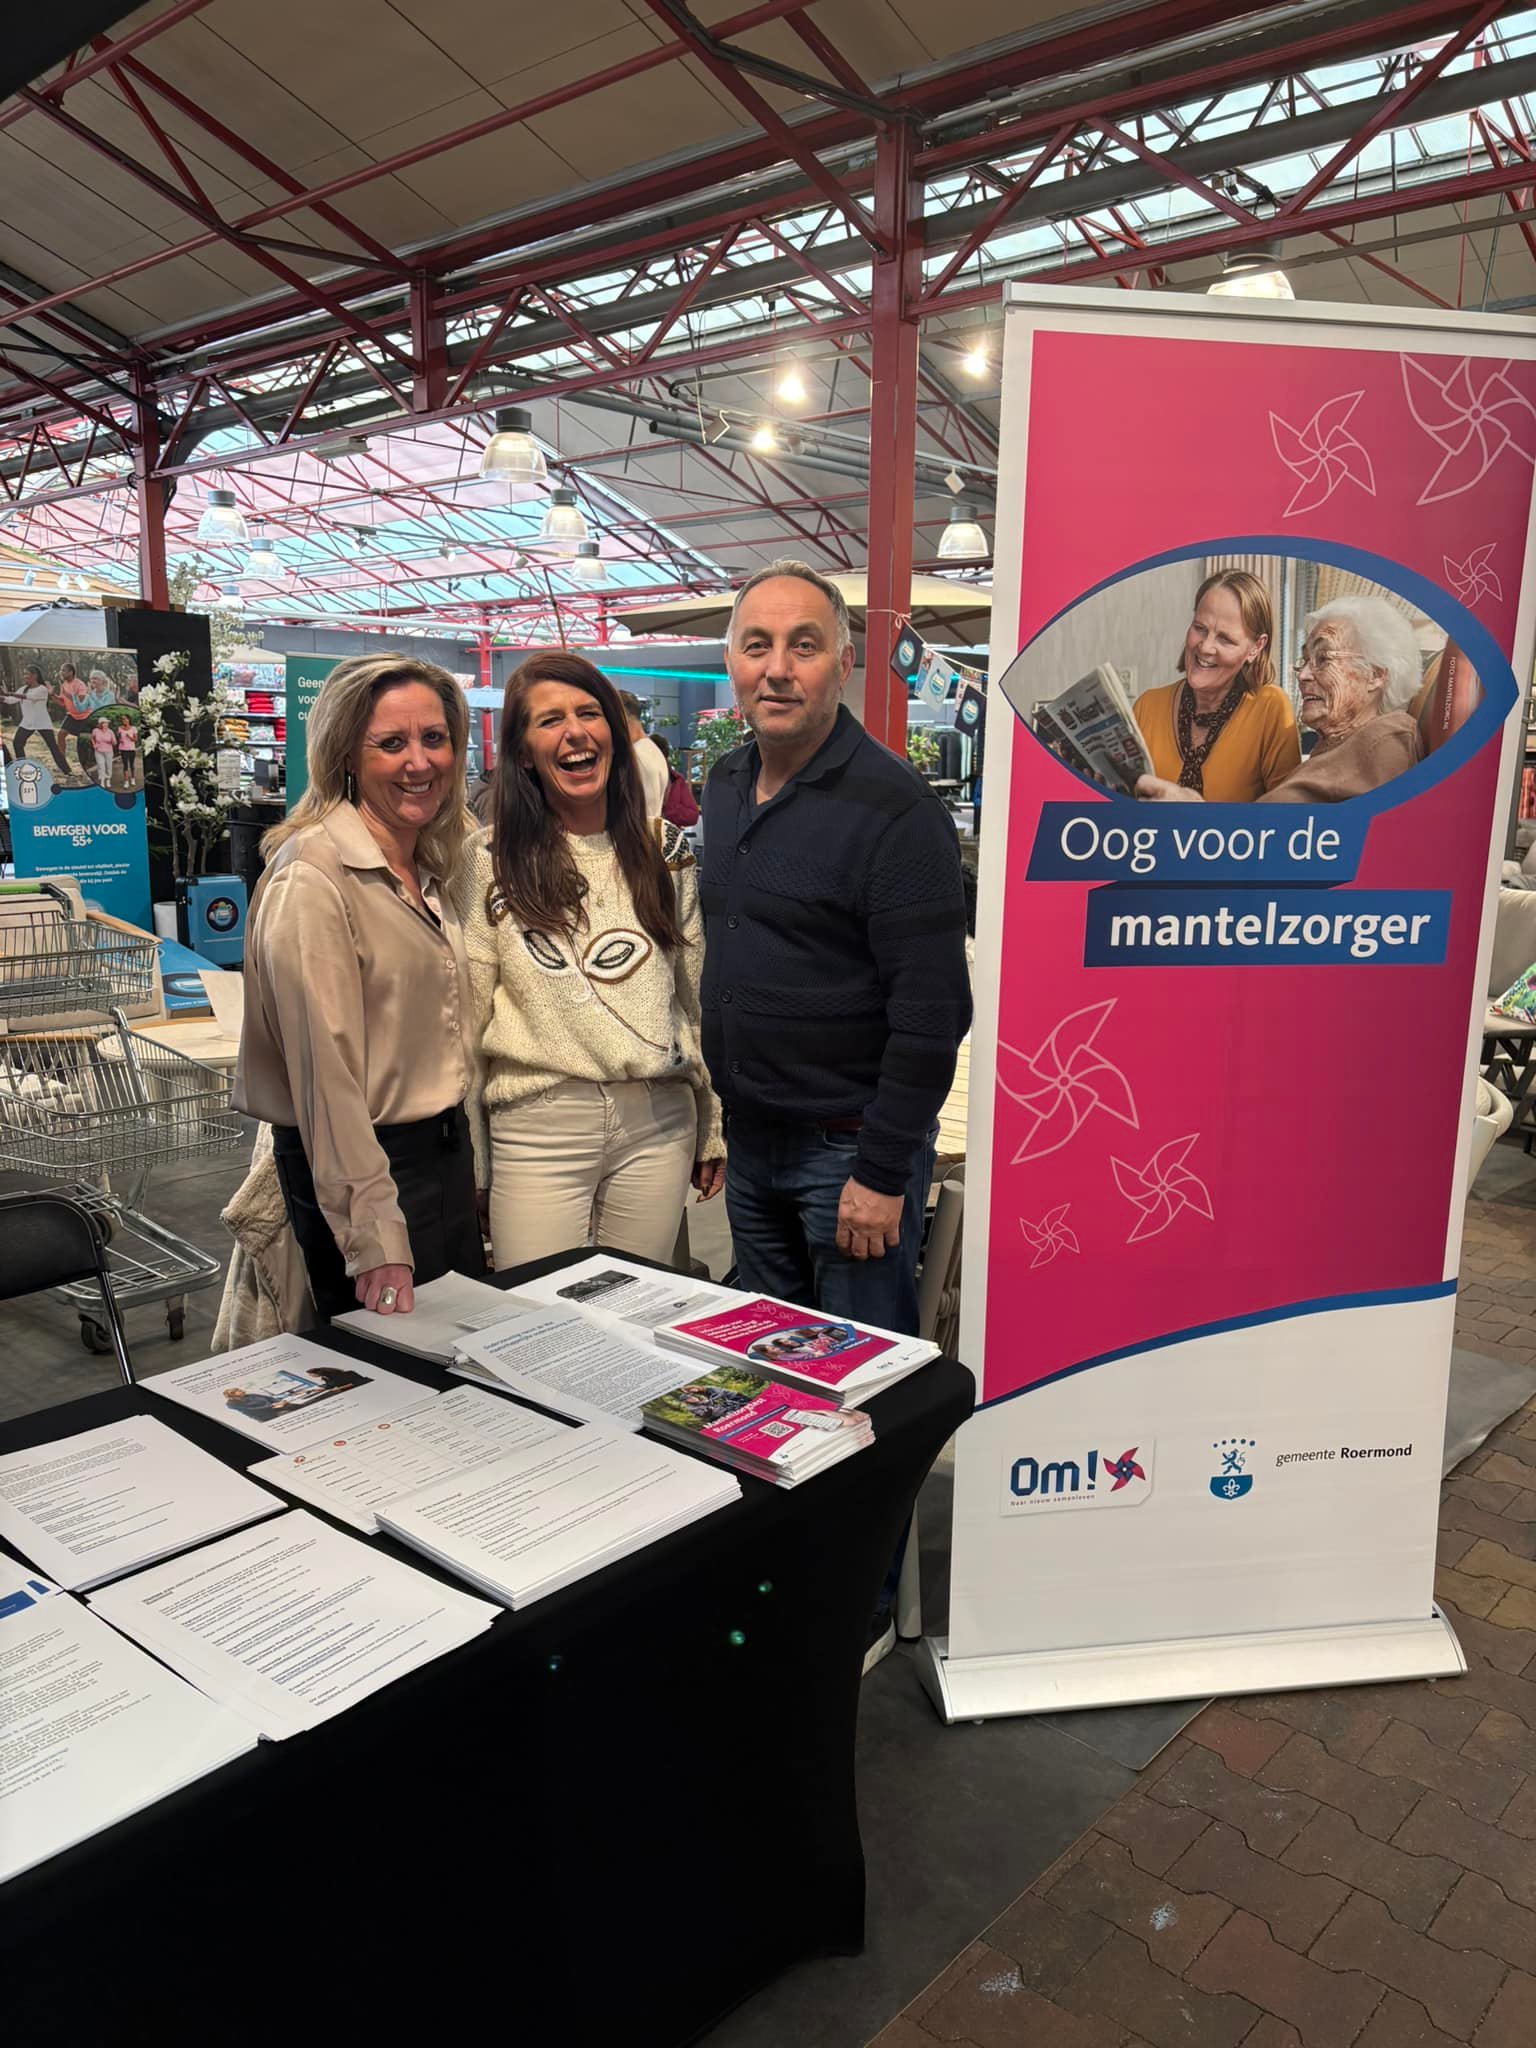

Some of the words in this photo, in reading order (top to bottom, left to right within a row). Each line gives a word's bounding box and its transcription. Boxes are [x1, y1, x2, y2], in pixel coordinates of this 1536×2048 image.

[297, 695, 317, 705] voo
[33, 825, 91, 837] BEWEGEN
[92, 823, 128, 835] VOOR
[72, 836, 93, 847] 55+
[1060, 816, 1158, 874] Oog
[1172, 829, 1276, 861] voor
[1288, 816, 1341, 861] de
[1110, 902, 1431, 958] mantelzorger
[1275, 1449, 1336, 1468] gemeente
[1340, 1443, 1413, 1459] Roermond
[1010, 1449, 1099, 1497] Om!
